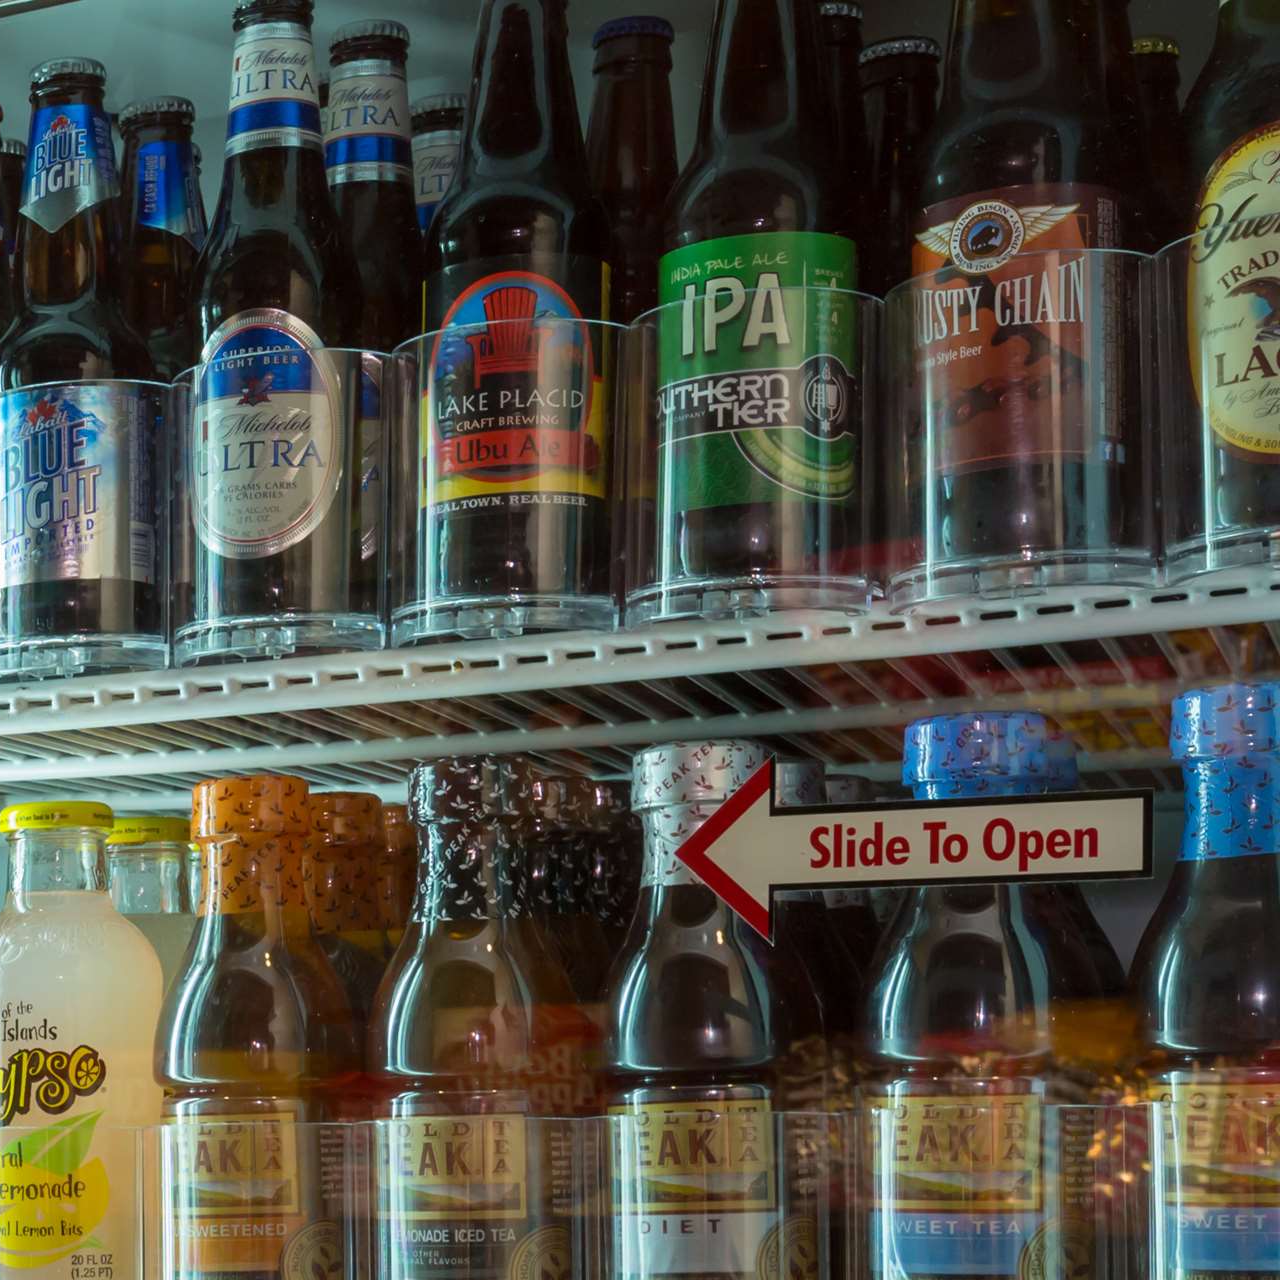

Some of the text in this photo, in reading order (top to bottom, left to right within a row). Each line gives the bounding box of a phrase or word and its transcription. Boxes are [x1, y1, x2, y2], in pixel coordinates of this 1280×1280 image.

[34, 129, 88, 176] BLUE
[30, 157, 92, 201] LIGHT
[977, 204, 1009, 215] BISON
[670, 251, 790, 285] INDIA PALE ALE
[994, 255, 1087, 328] CHAIN
[680, 272, 791, 357] IPA
[213, 354, 300, 373] LIGHT BEER
[959, 344, 983, 361] Beer
[438, 387, 585, 420] LAKE PLACID
[708, 399, 791, 428] TIER
[219, 410, 313, 443] Michelob
[455, 414, 560, 433] CRAFT BREWING
[4, 416, 90, 493] BLUE
[455, 441, 509, 465] Ubu
[0, 464, 102, 545] LIGHT
[508, 494, 551, 506] REAL
[654, 762, 691, 798] PEAK
[444, 823, 472, 861] PEAK
[808, 816, 1100, 873] Slide To Open
[1, 1000, 33, 1019] of the
[1, 1018, 58, 1042] Islands
[14, 1219, 84, 1237] Lemon Bits
[454, 1228, 517, 1243] ICED TEA
[972, 1219, 1022, 1236] TEA
[71, 1254, 114, 1266] 20 FL OZ
[71, 1267, 114, 1279] (1.25 PT)
